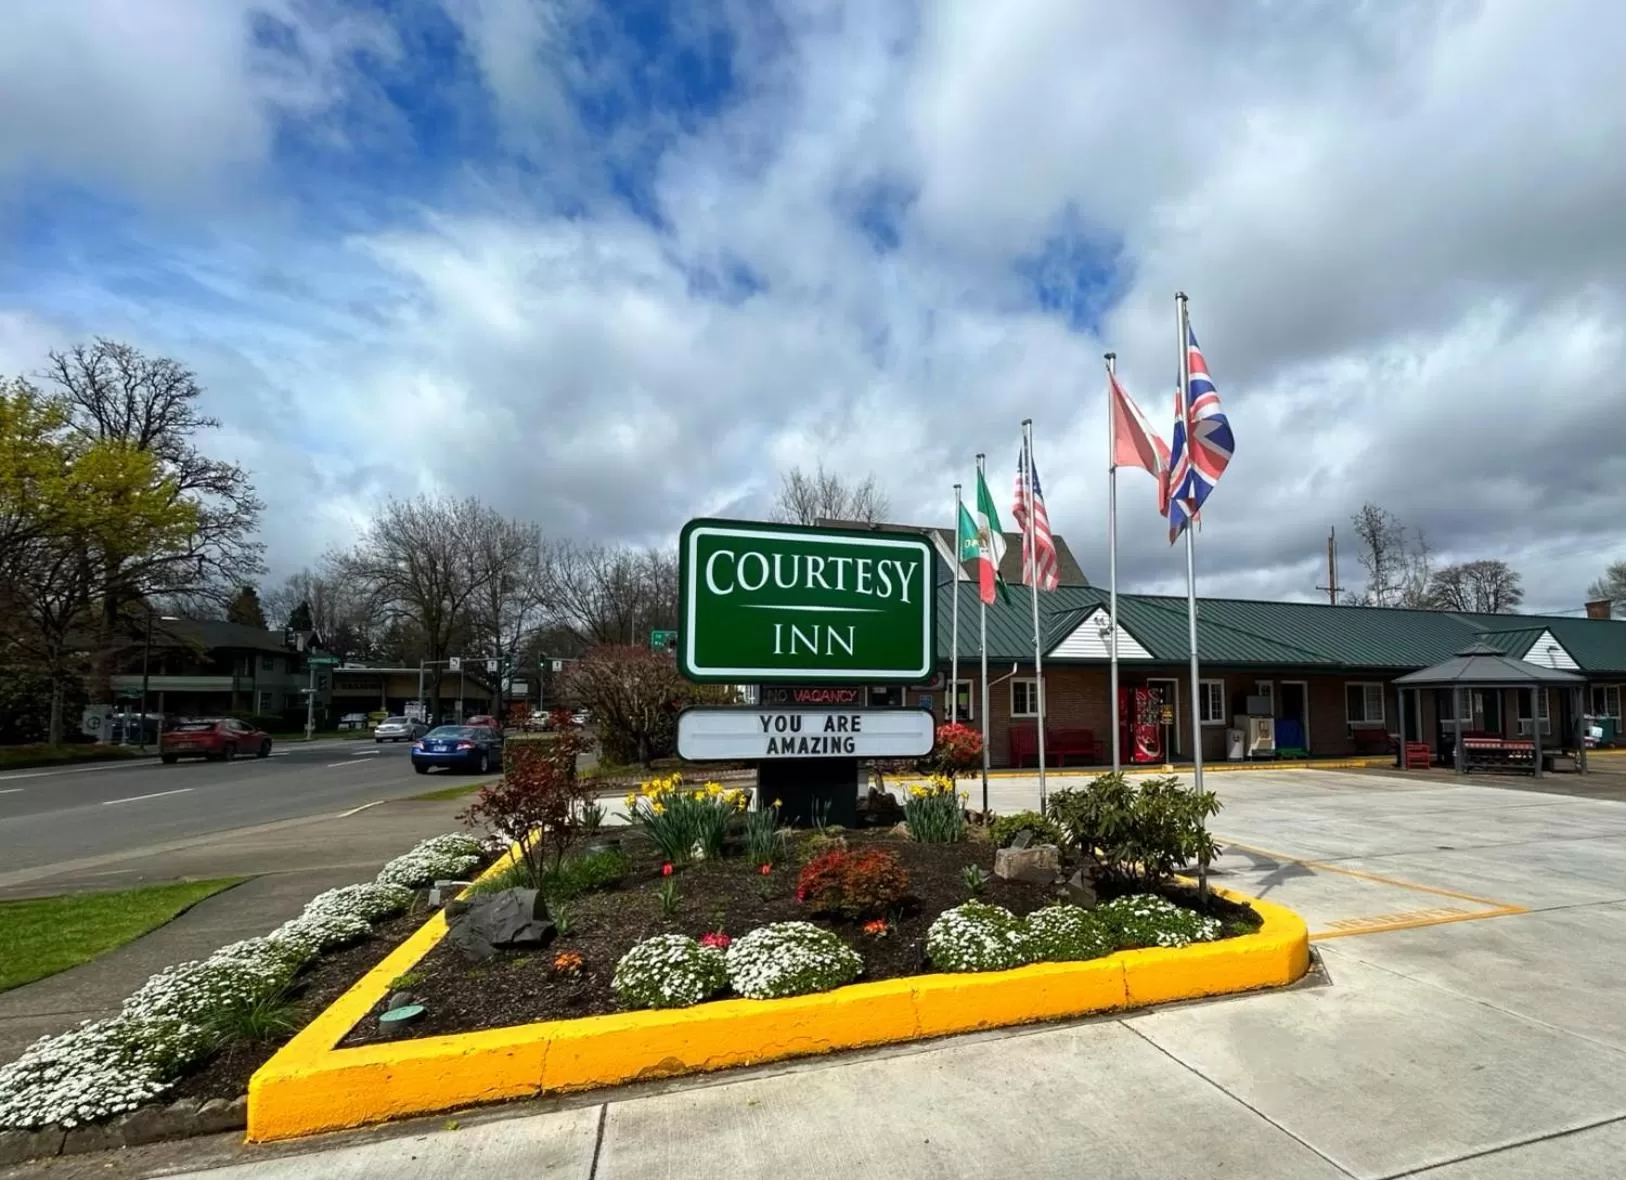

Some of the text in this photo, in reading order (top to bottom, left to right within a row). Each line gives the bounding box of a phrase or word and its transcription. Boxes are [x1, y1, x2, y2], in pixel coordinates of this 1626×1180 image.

[705, 549, 918, 604] COURTESY
[772, 623, 856, 657] INN
[793, 689, 857, 703] VACANCY
[759, 715, 862, 733] YOU ARE
[766, 736, 856, 755] AMAZING
